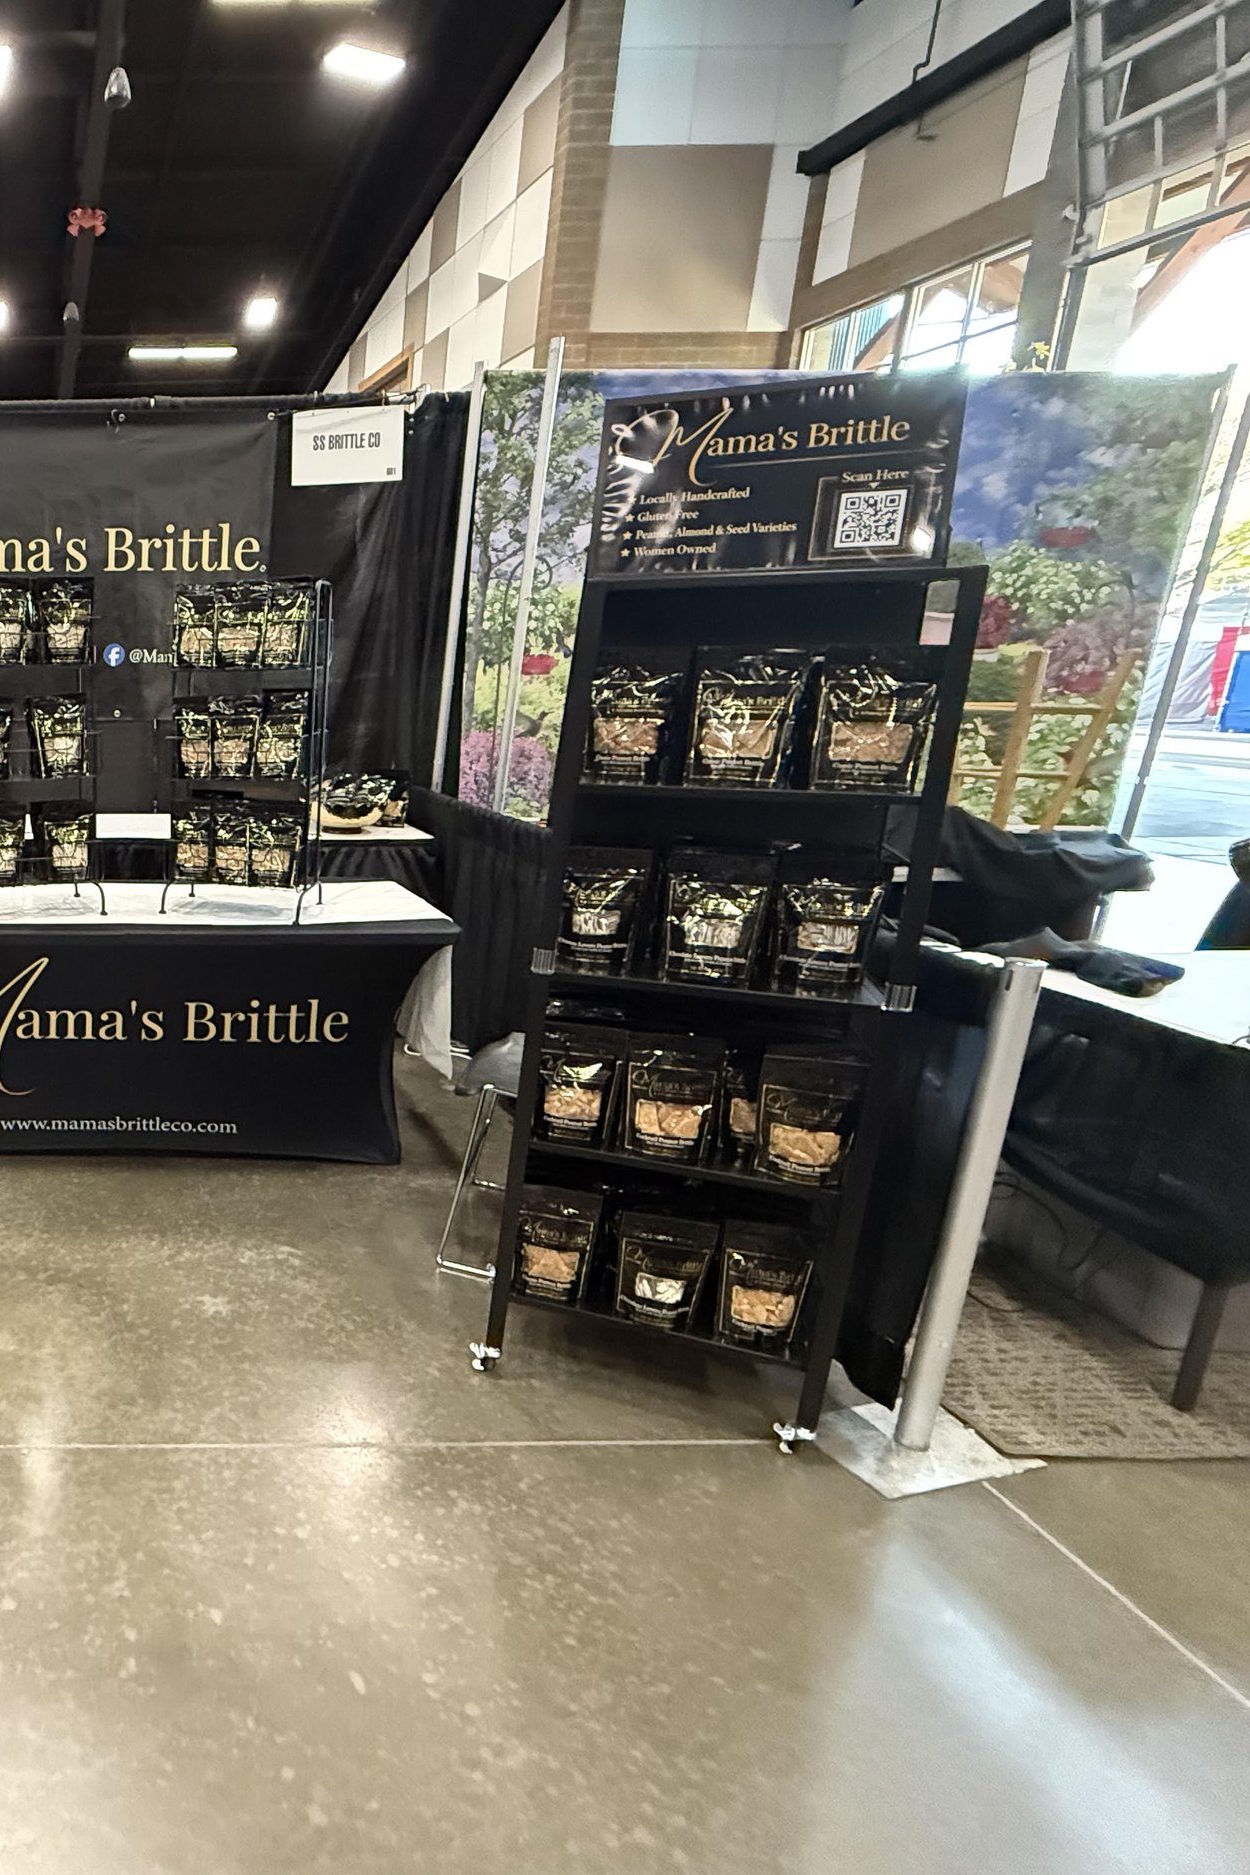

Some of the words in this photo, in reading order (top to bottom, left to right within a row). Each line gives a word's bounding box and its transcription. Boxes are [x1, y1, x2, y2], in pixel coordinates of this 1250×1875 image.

[313, 435, 326, 451] SS
[328, 433, 366, 450] BRITTLE
[368, 432, 381, 448] CO
[611, 407, 798, 486] Mama's
[808, 415, 911, 449] Brittle
[842, 471, 873, 483] Scan
[876, 469, 910, 480] Here
[682, 487, 750, 502] Handcrafted
[637, 511, 674, 522] Glute
[675, 526, 714, 538] Almond
[716, 525, 724, 535] &
[726, 523, 750, 535] Seed
[752, 521, 797, 534] Varieties
[103, 522, 260, 572] Brittle
[634, 546, 674, 557] Women
[677, 543, 717, 555] Owned
[182, 999, 349, 1044] Brittle
[0, 1116, 237, 1134] www.mamasbrittleco.com
